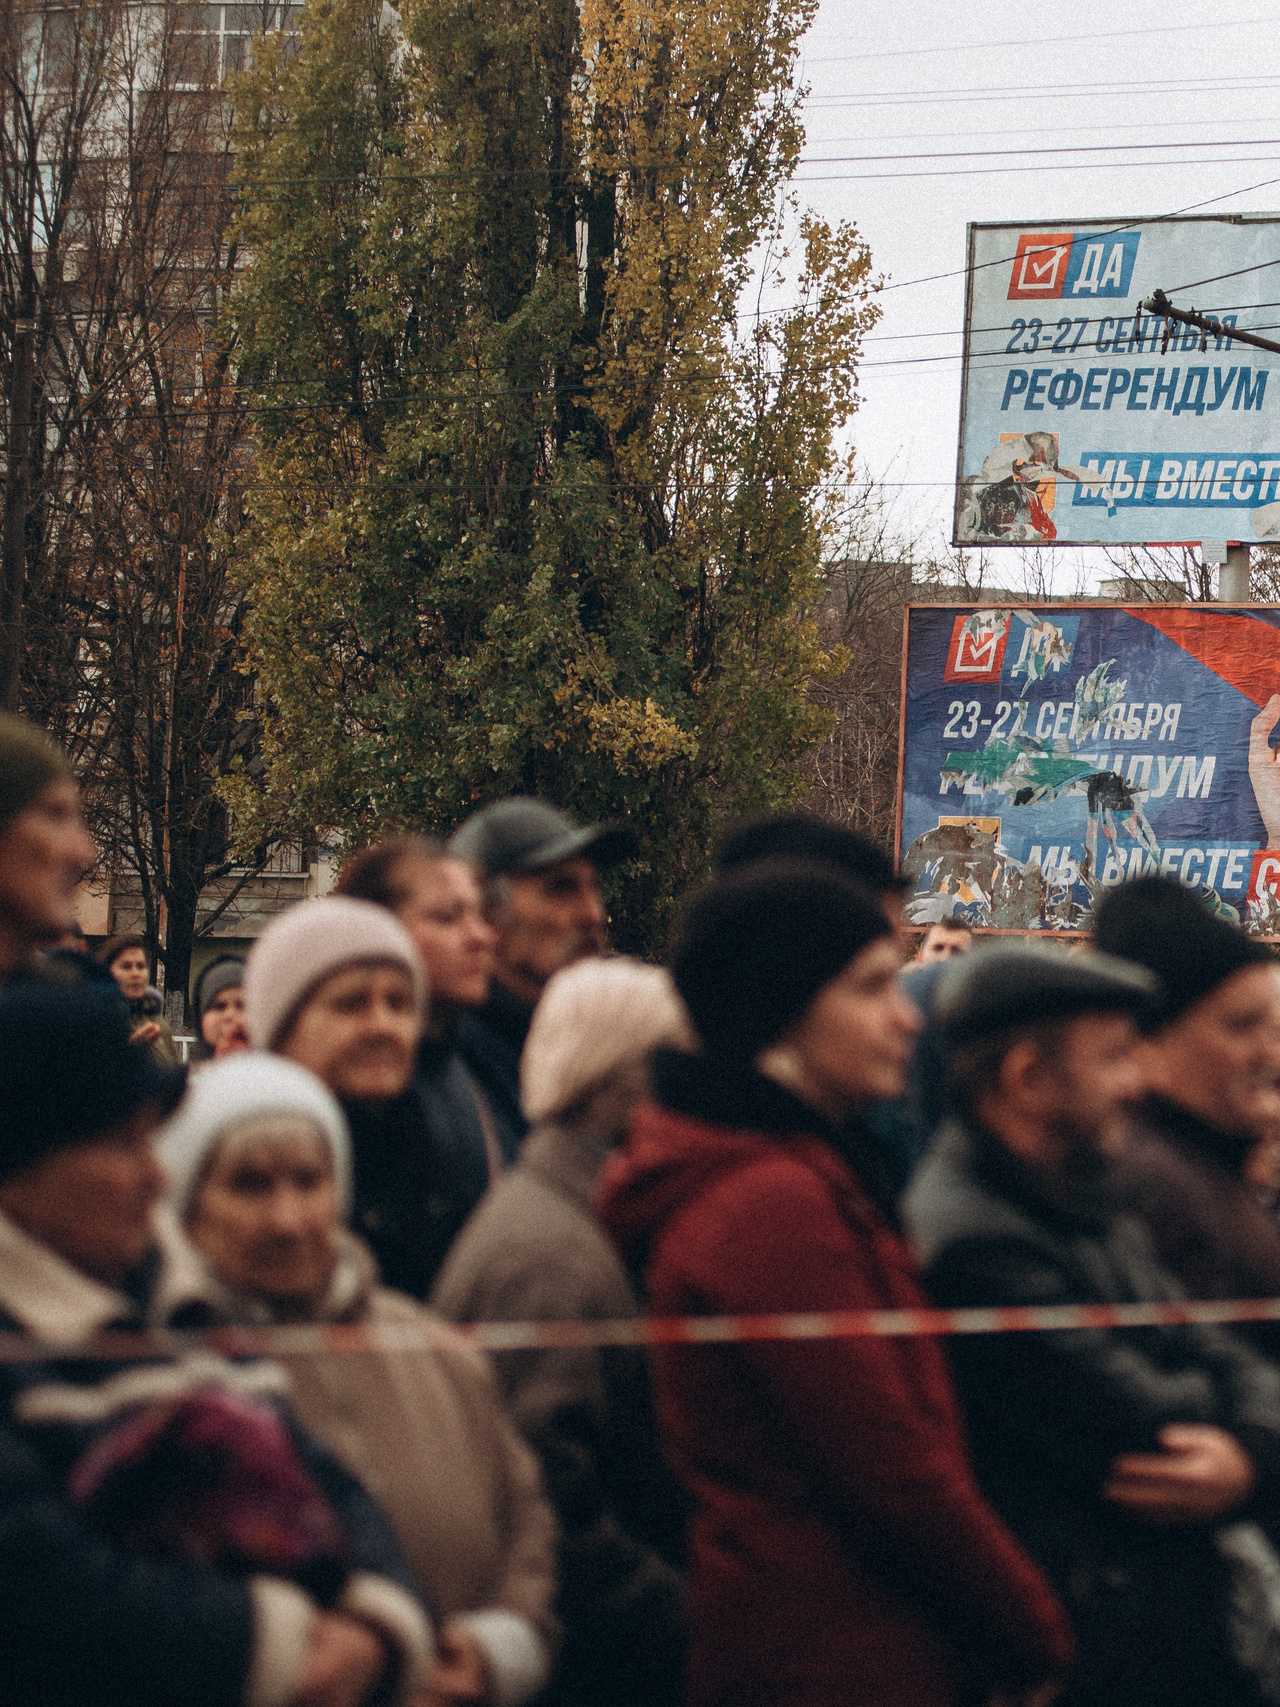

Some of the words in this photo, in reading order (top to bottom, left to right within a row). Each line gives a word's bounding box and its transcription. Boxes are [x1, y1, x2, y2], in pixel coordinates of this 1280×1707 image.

[1072, 243, 1124, 294] ДА
[1005, 317, 1090, 354] 23-27
[1000, 366, 1270, 416] РЕФЕРЕНДУМ
[1079, 459, 1150, 500] МЫ
[942, 700, 1030, 740] 23-27
[1101, 847, 1250, 890] ВМЕСТЕ
